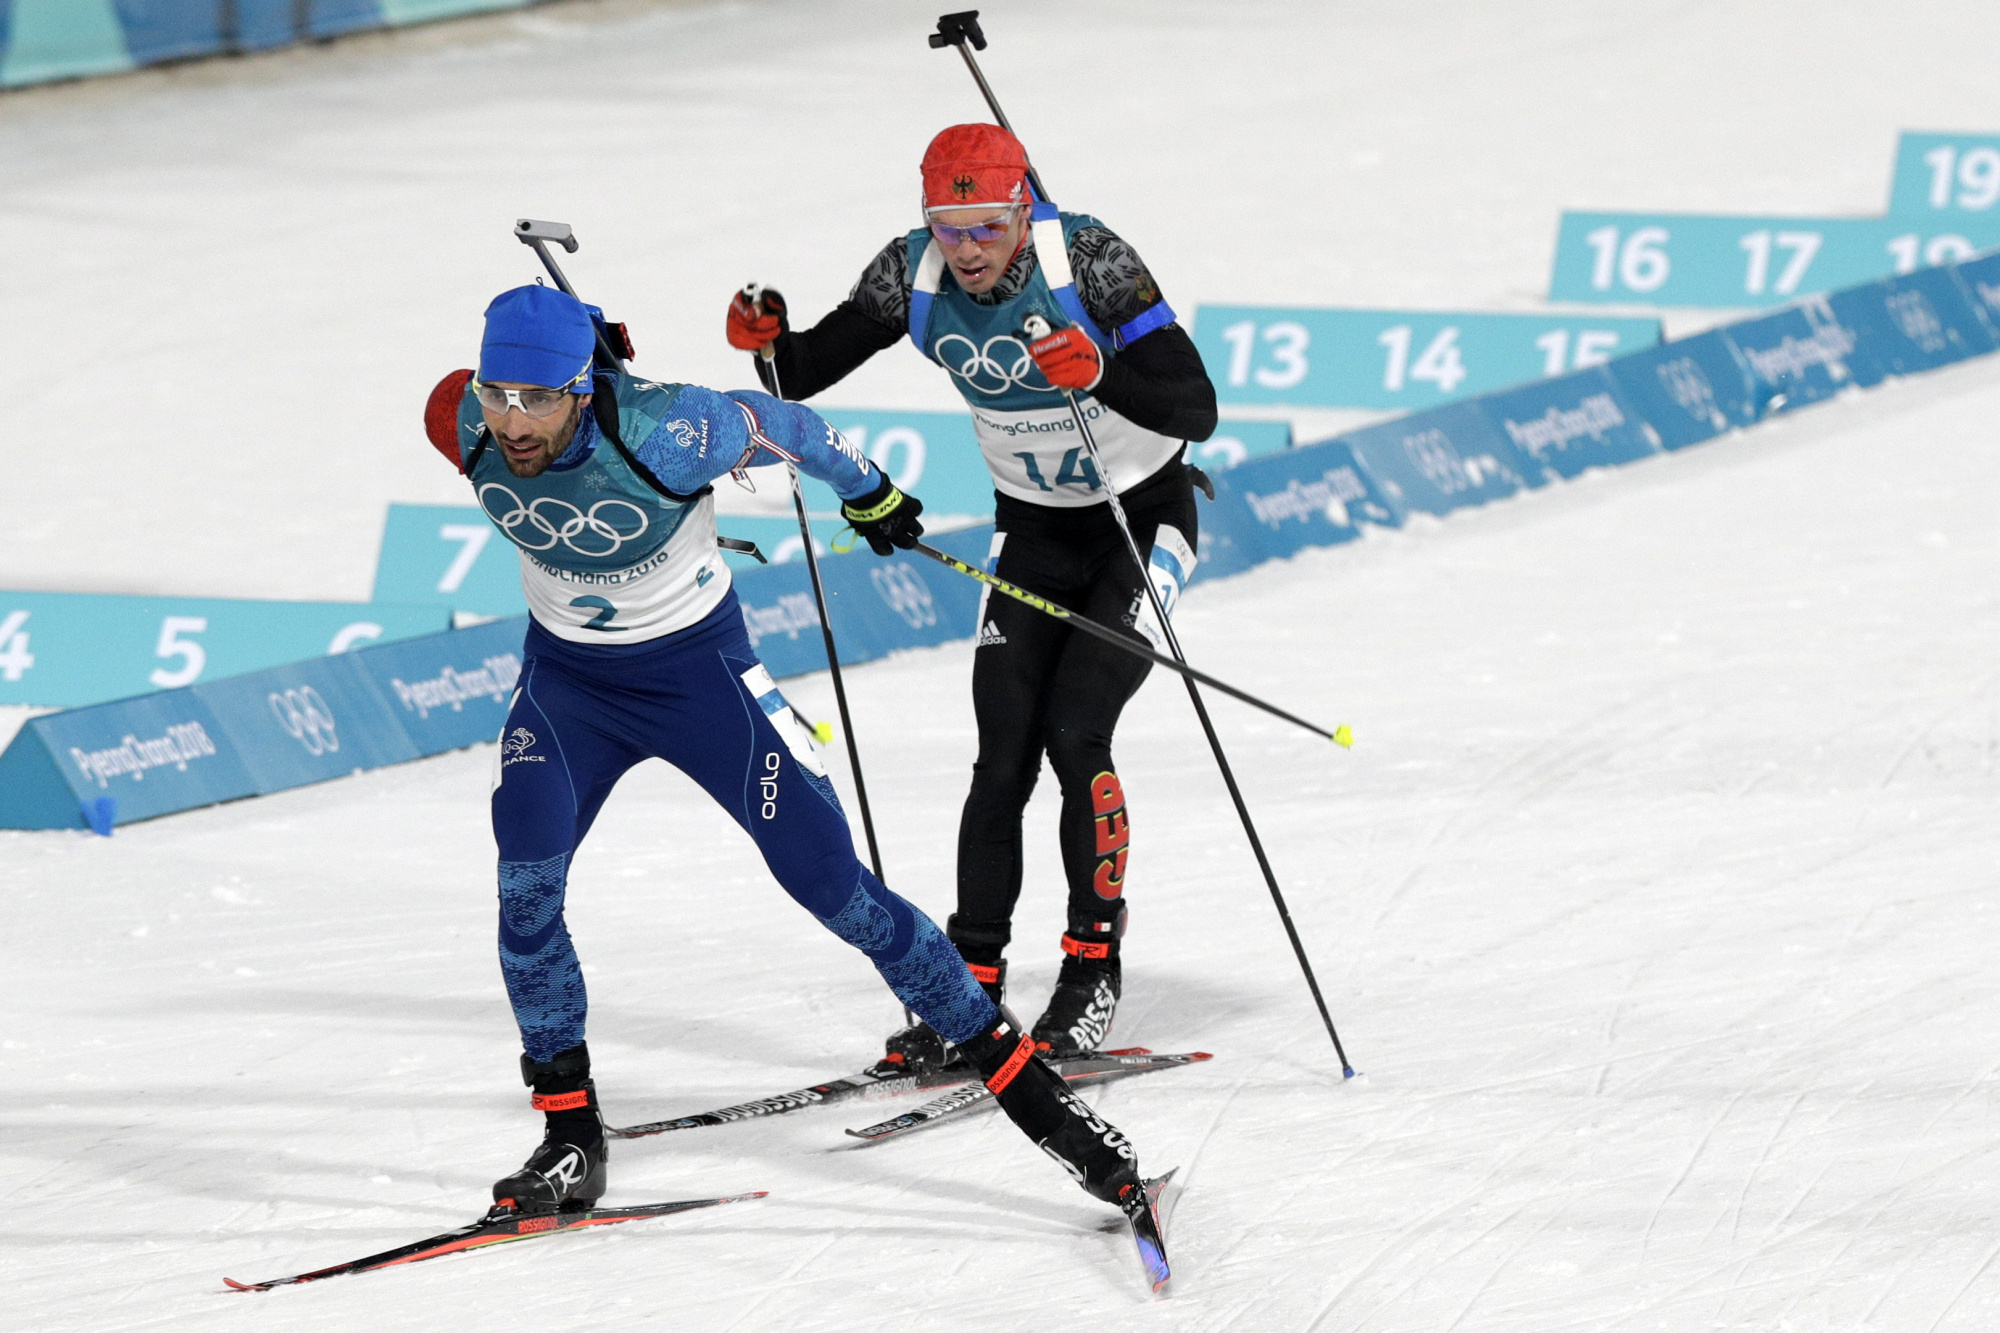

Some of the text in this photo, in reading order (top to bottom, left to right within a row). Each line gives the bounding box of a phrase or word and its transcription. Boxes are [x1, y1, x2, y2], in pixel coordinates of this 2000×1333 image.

[1923, 146, 2000, 211] 19
[1585, 226, 1671, 292] 16
[1739, 229, 1823, 295] 17
[1222, 319, 1311, 389] 13
[1378, 325, 1466, 392] 14
[698, 418, 709, 459] FRANCE
[1012, 446, 1101, 491] 14
[437, 525, 492, 592] 7
[568, 594, 629, 632] 2
[148, 616, 208, 688] 5
[503, 755, 546, 767] RANCE
[760, 752, 781, 820] odlo
[1091, 770, 1129, 901] GER
[549, 1094, 588, 1107] ROSSIGNO
[866, 1076, 919, 1097] ROSSIGNOL
[990, 1060, 1020, 1091] OSSIGNOL
